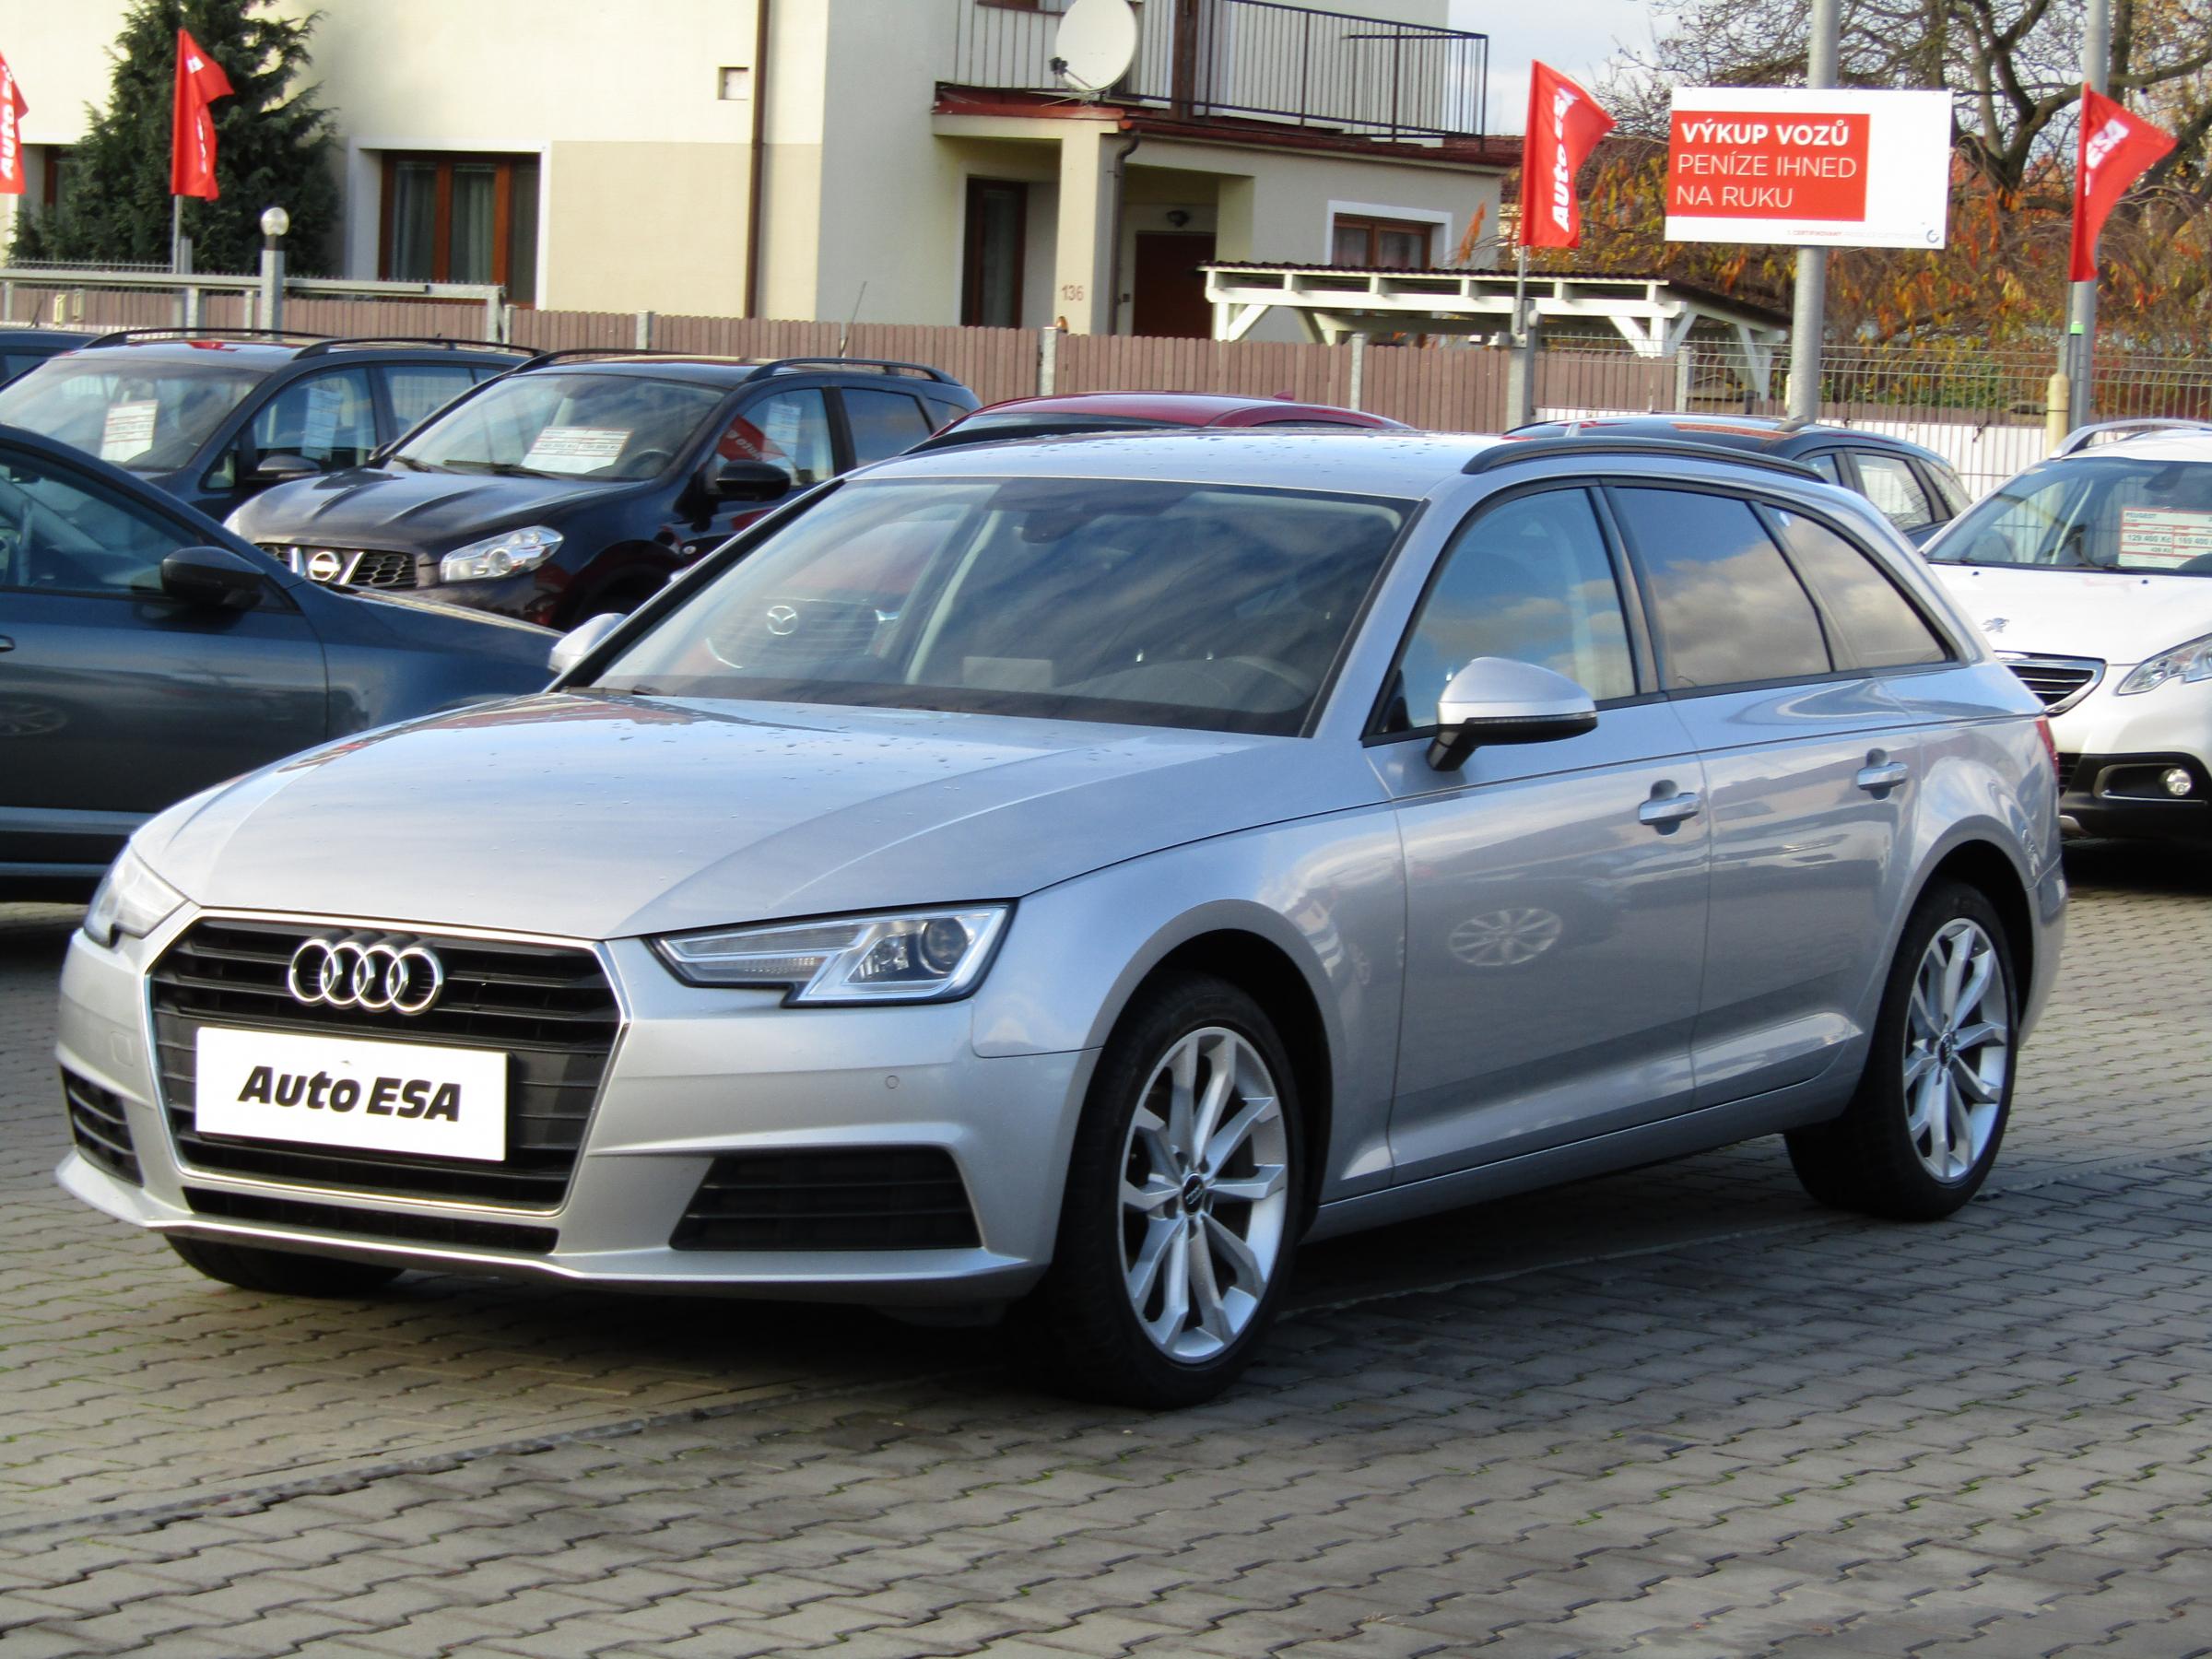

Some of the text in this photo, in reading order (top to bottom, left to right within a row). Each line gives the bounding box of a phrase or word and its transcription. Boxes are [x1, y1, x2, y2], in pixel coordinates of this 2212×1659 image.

[1681, 119, 1849, 146] VÝKUP VOZŮ
[1677, 151, 1857, 178] PENÍZE IHNED
[1677, 185, 1794, 208] NA RUKU
[1061, 284, 1084, 301] 136
[237, 1065, 461, 1122] Auto ESA
